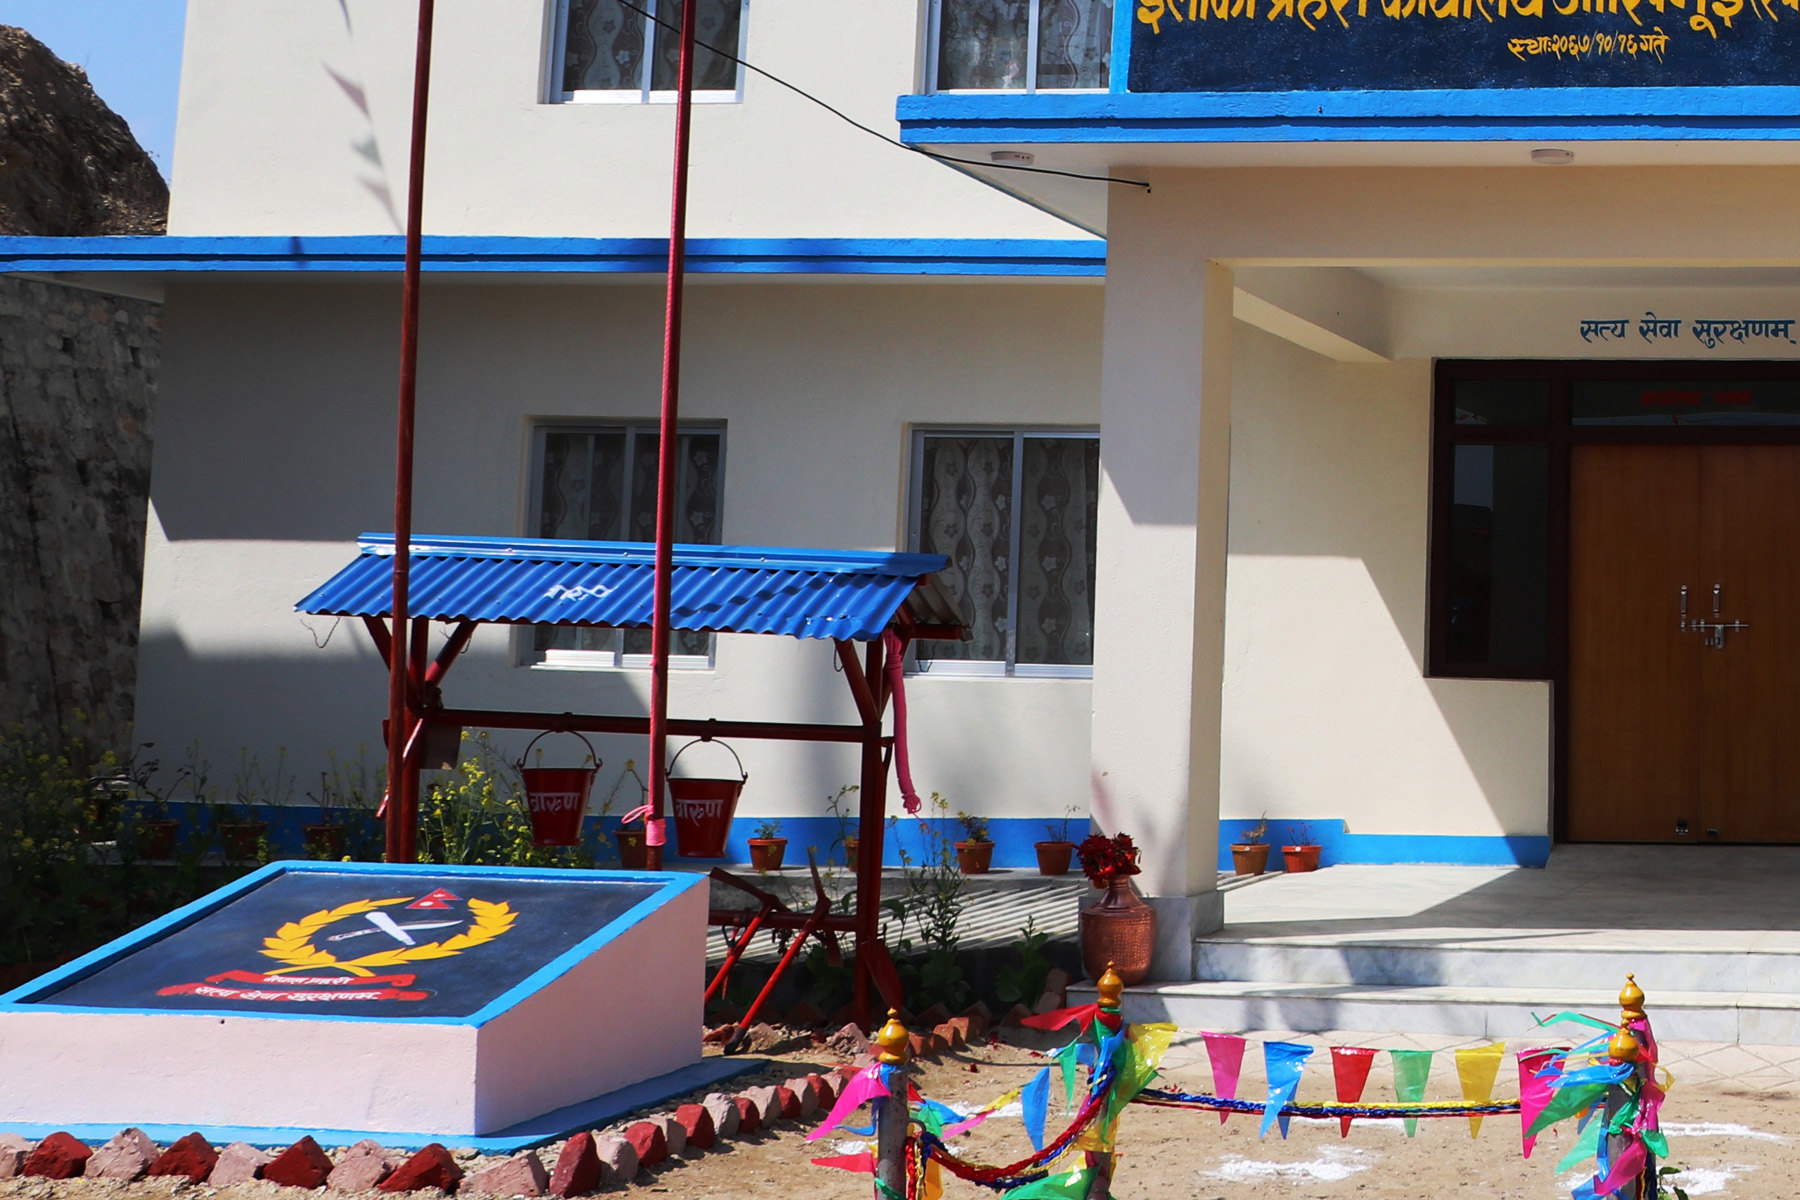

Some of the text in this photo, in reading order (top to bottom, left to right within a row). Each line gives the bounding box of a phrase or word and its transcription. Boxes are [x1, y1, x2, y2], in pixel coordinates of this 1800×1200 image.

[1579, 311, 1798, 349] सत्य सेवा सुरक्षणम्
